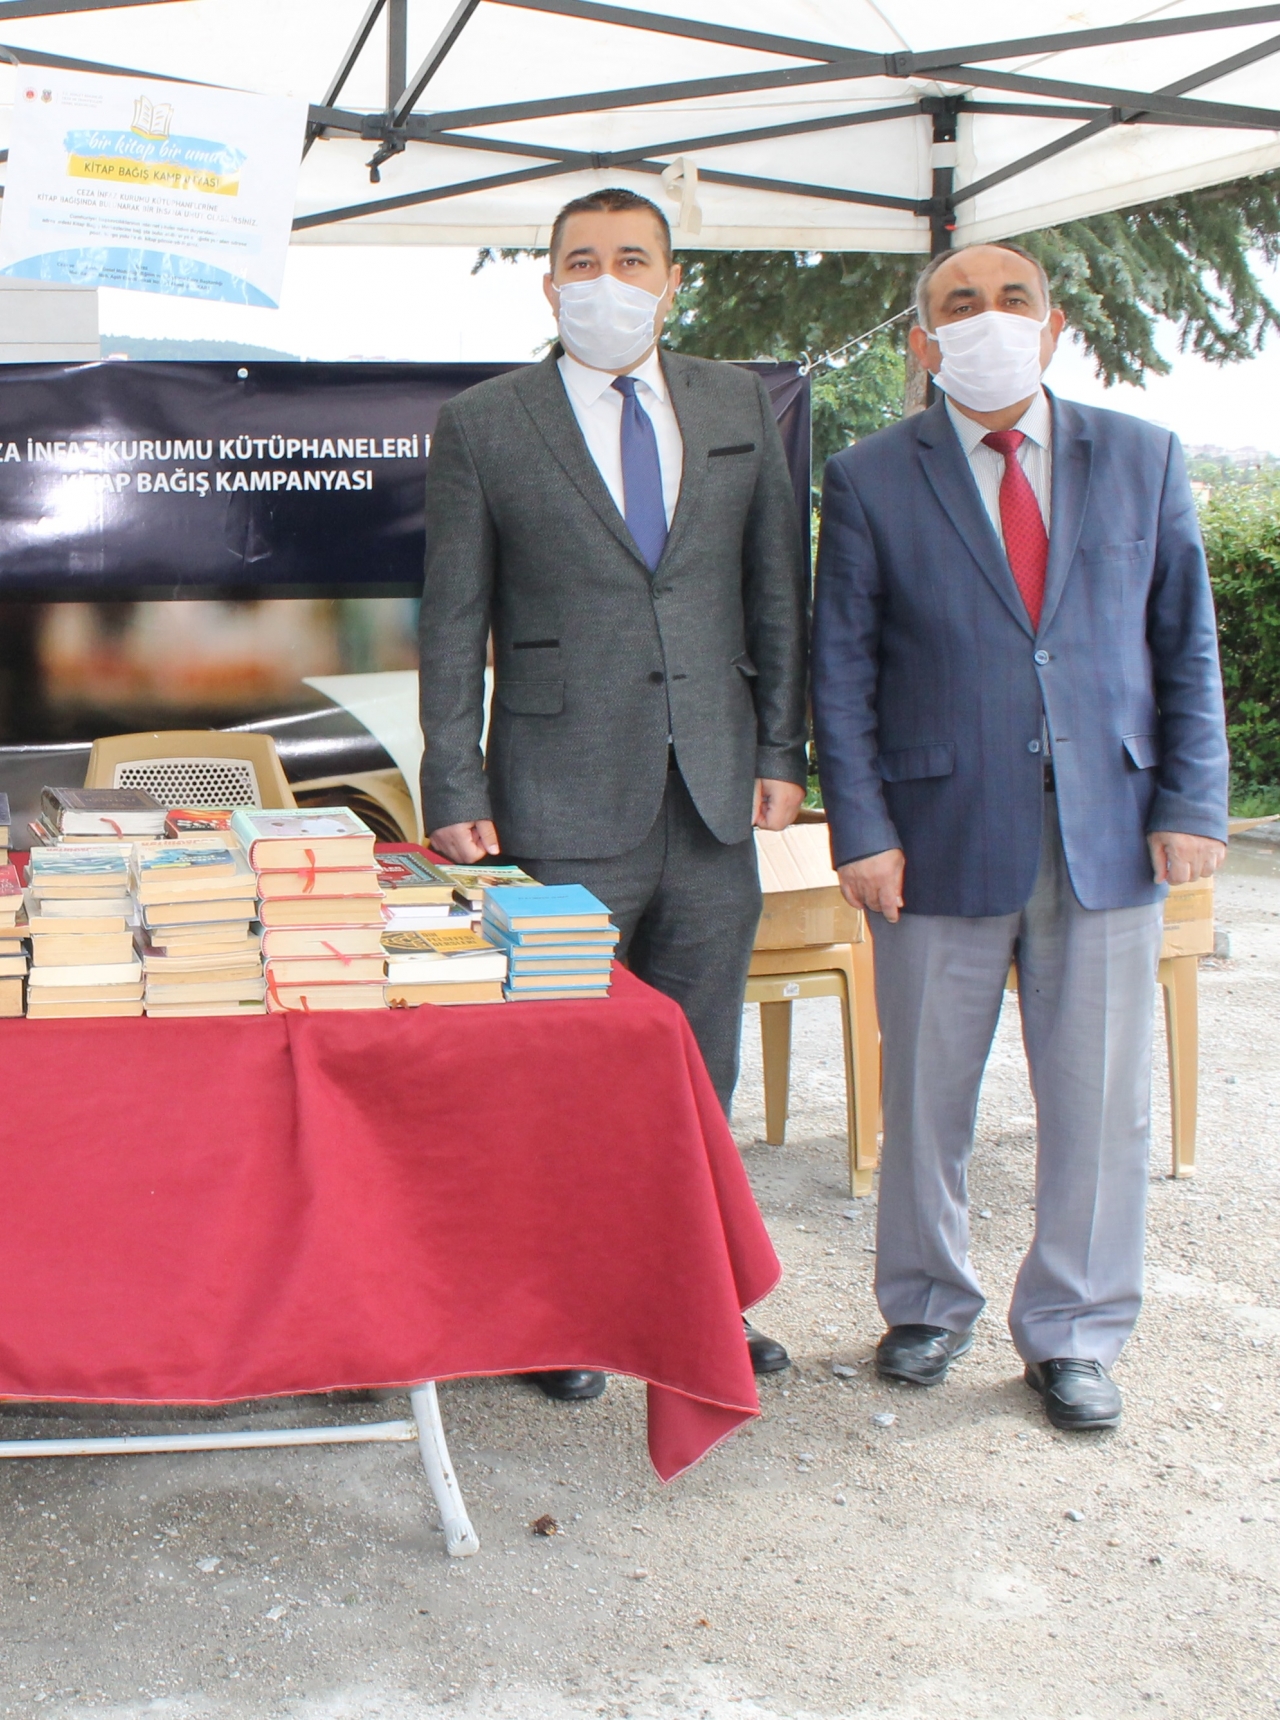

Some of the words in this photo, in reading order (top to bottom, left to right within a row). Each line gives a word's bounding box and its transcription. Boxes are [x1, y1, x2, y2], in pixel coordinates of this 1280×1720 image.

[89, 132, 111, 148] bir
[114, 135, 155, 161] kitap
[158, 139, 182, 158] bir
[84, 161, 114, 174] KİTAP
[118, 165, 149, 180] BAĞIŞ
[76, 188, 95, 197] CEZA
[104, 439, 212, 462] KURUMU
[220, 434, 419, 460] KÜTÜPHANELERİ
[137, 467, 209, 497] BAĞIŞ
[216, 469, 373, 492] KAMPANYASI
